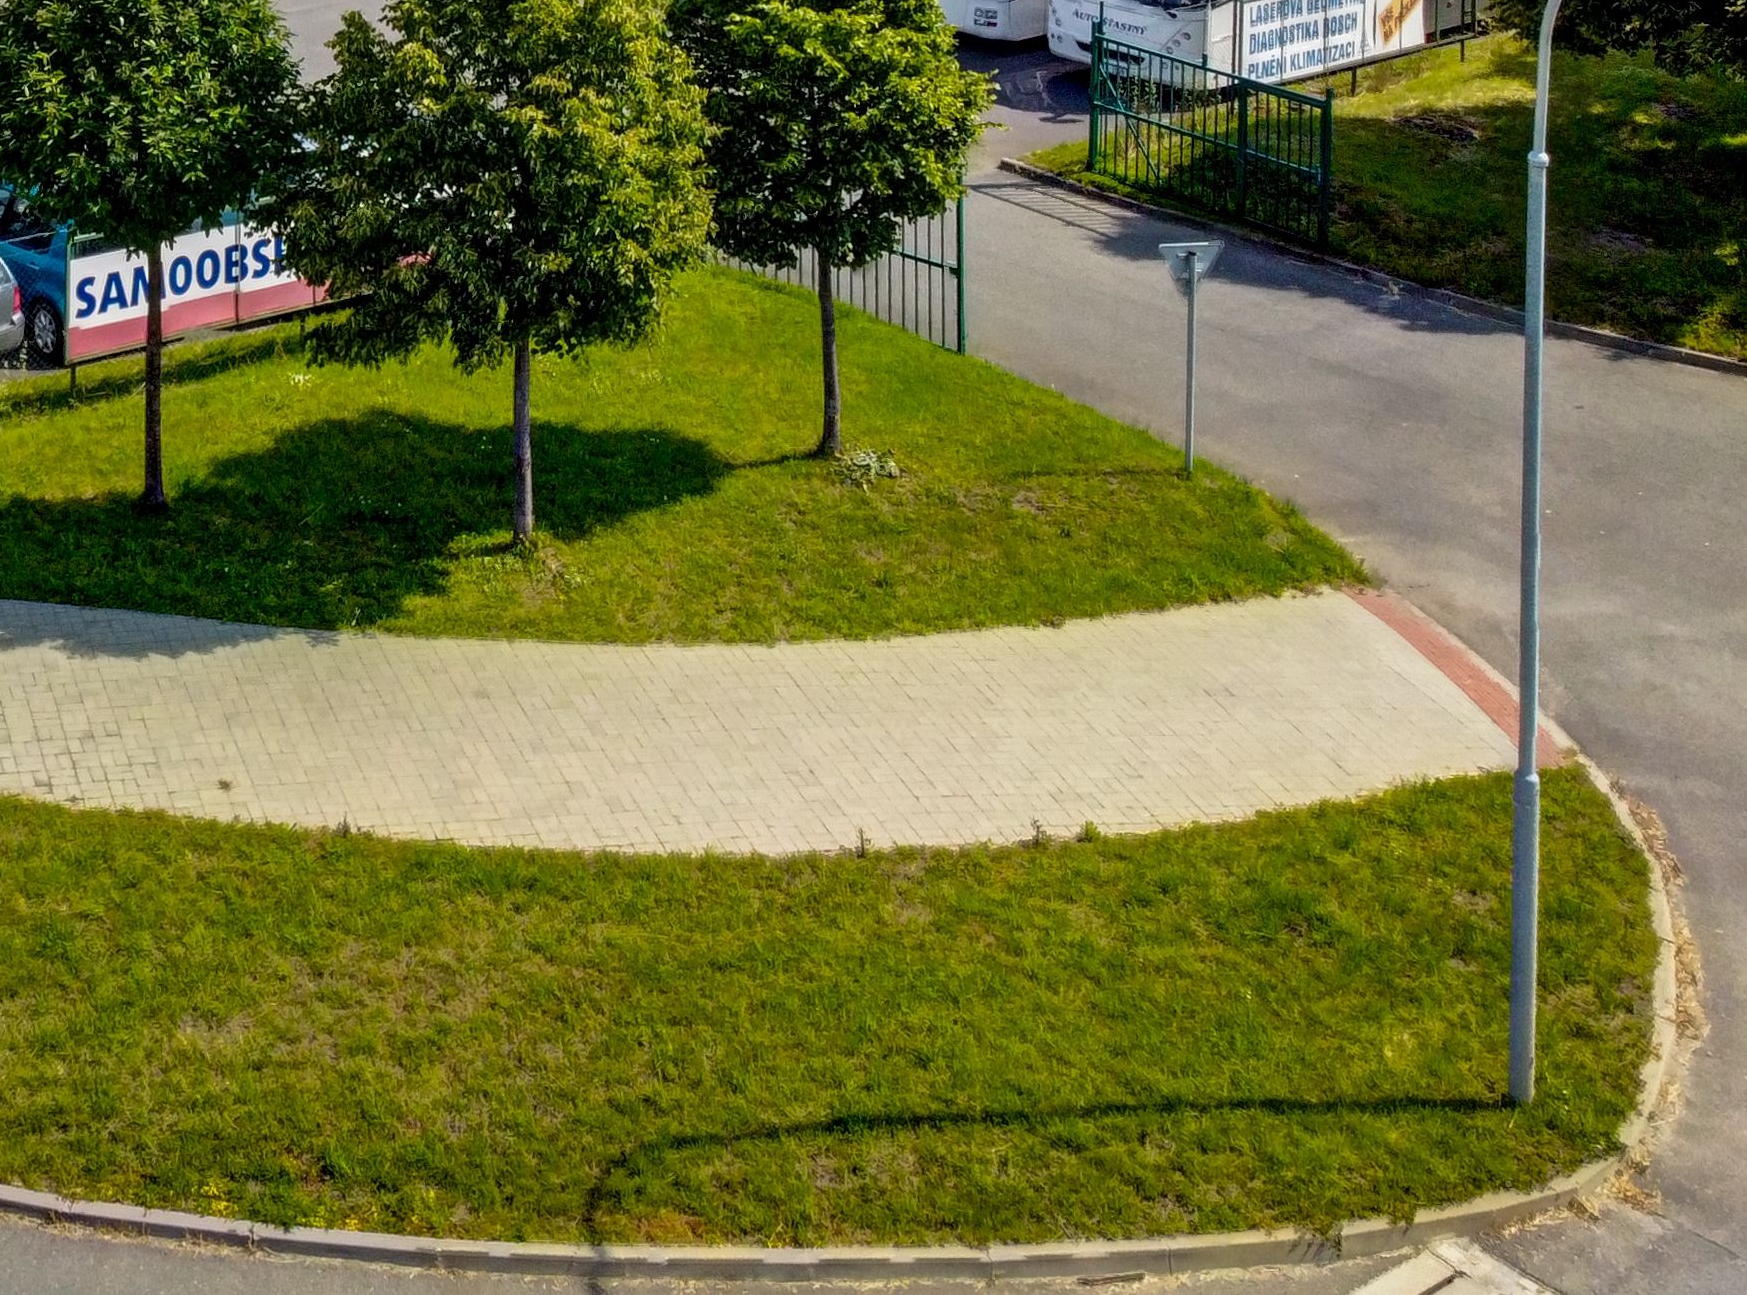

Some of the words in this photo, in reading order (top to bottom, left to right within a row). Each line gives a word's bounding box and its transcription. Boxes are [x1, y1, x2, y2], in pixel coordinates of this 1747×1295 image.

[1072, 8, 1099, 23] AUTO
[1249, 19, 1319, 55] DIAGNOSTIKA
[1322, 11, 1358, 39] BOSCH
